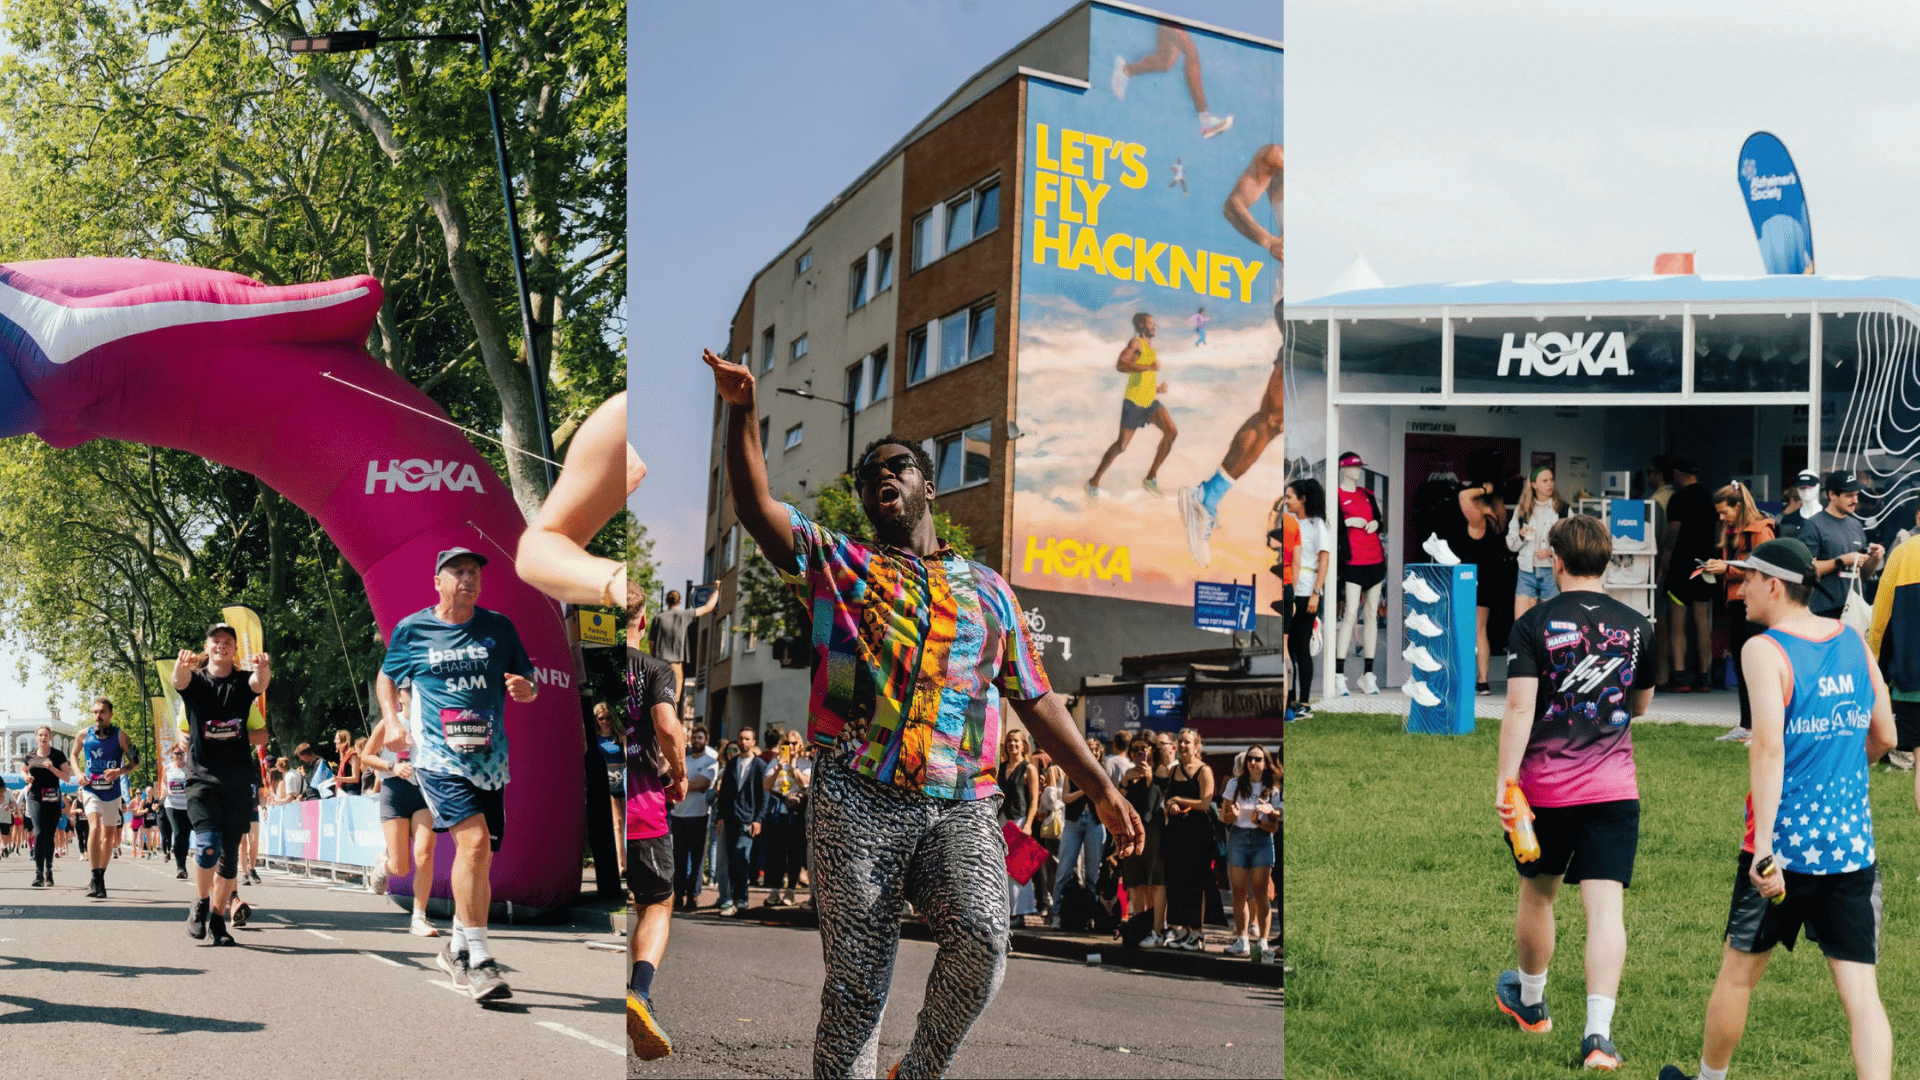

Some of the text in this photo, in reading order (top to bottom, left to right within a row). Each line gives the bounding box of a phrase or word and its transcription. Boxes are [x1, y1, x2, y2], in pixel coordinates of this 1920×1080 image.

[1036, 123, 1149, 189] LET'S
[1034, 170, 1112, 226] FLY
[1033, 218, 1264, 304] HACKNEY
[1497, 331, 1630, 377] HOKA
[365, 458, 486, 495] HOKA
[1023, 535, 1132, 583] HOKA
[1547, 632, 1581, 648] HACKNEY
[429, 645, 490, 664] barts
[430, 659, 490, 675] CHARITY
[445, 674, 488, 693] SAM
[550, 668, 571, 689] FLY
[1818, 673, 1855, 697] SAM
[1785, 715, 1830, 734] Make
[86, 757, 118, 769] debra
